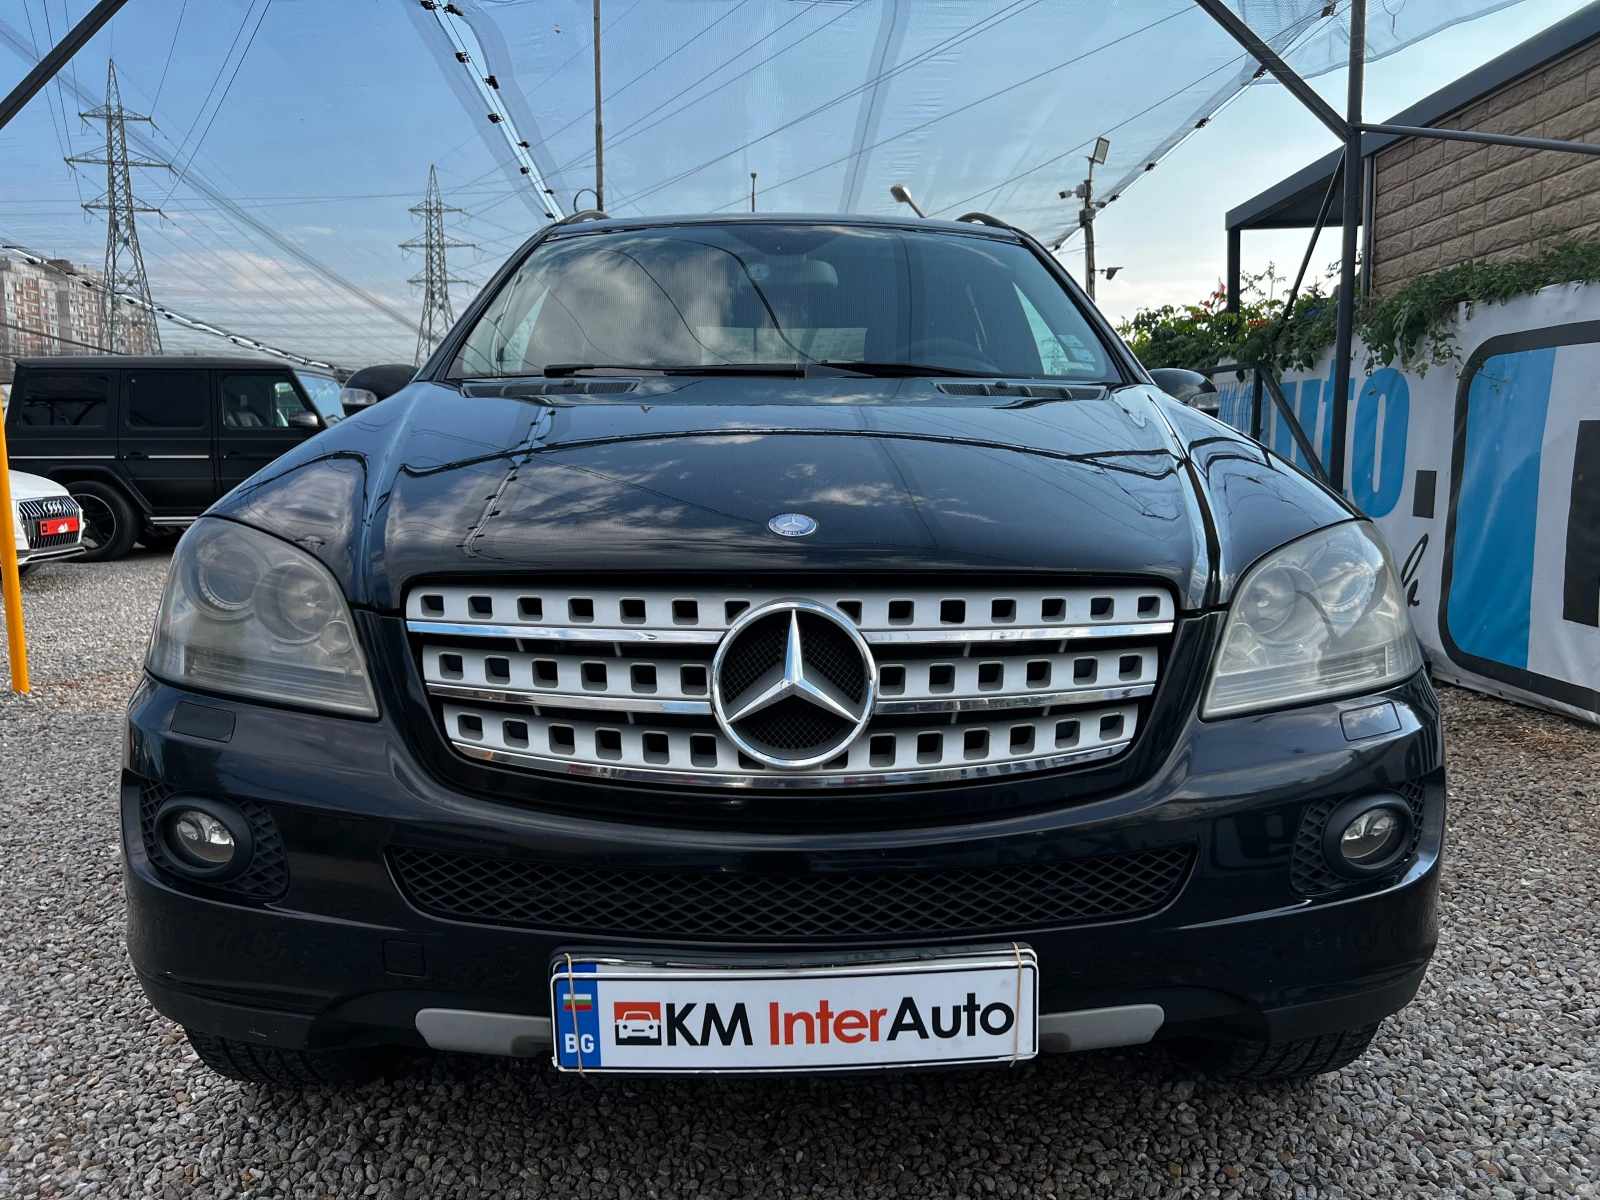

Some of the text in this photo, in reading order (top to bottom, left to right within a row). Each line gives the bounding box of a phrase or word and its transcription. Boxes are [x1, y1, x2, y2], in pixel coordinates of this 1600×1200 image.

[665, 992, 1015, 1046] KM InterAuto
[564, 1033, 595, 1054] BG
